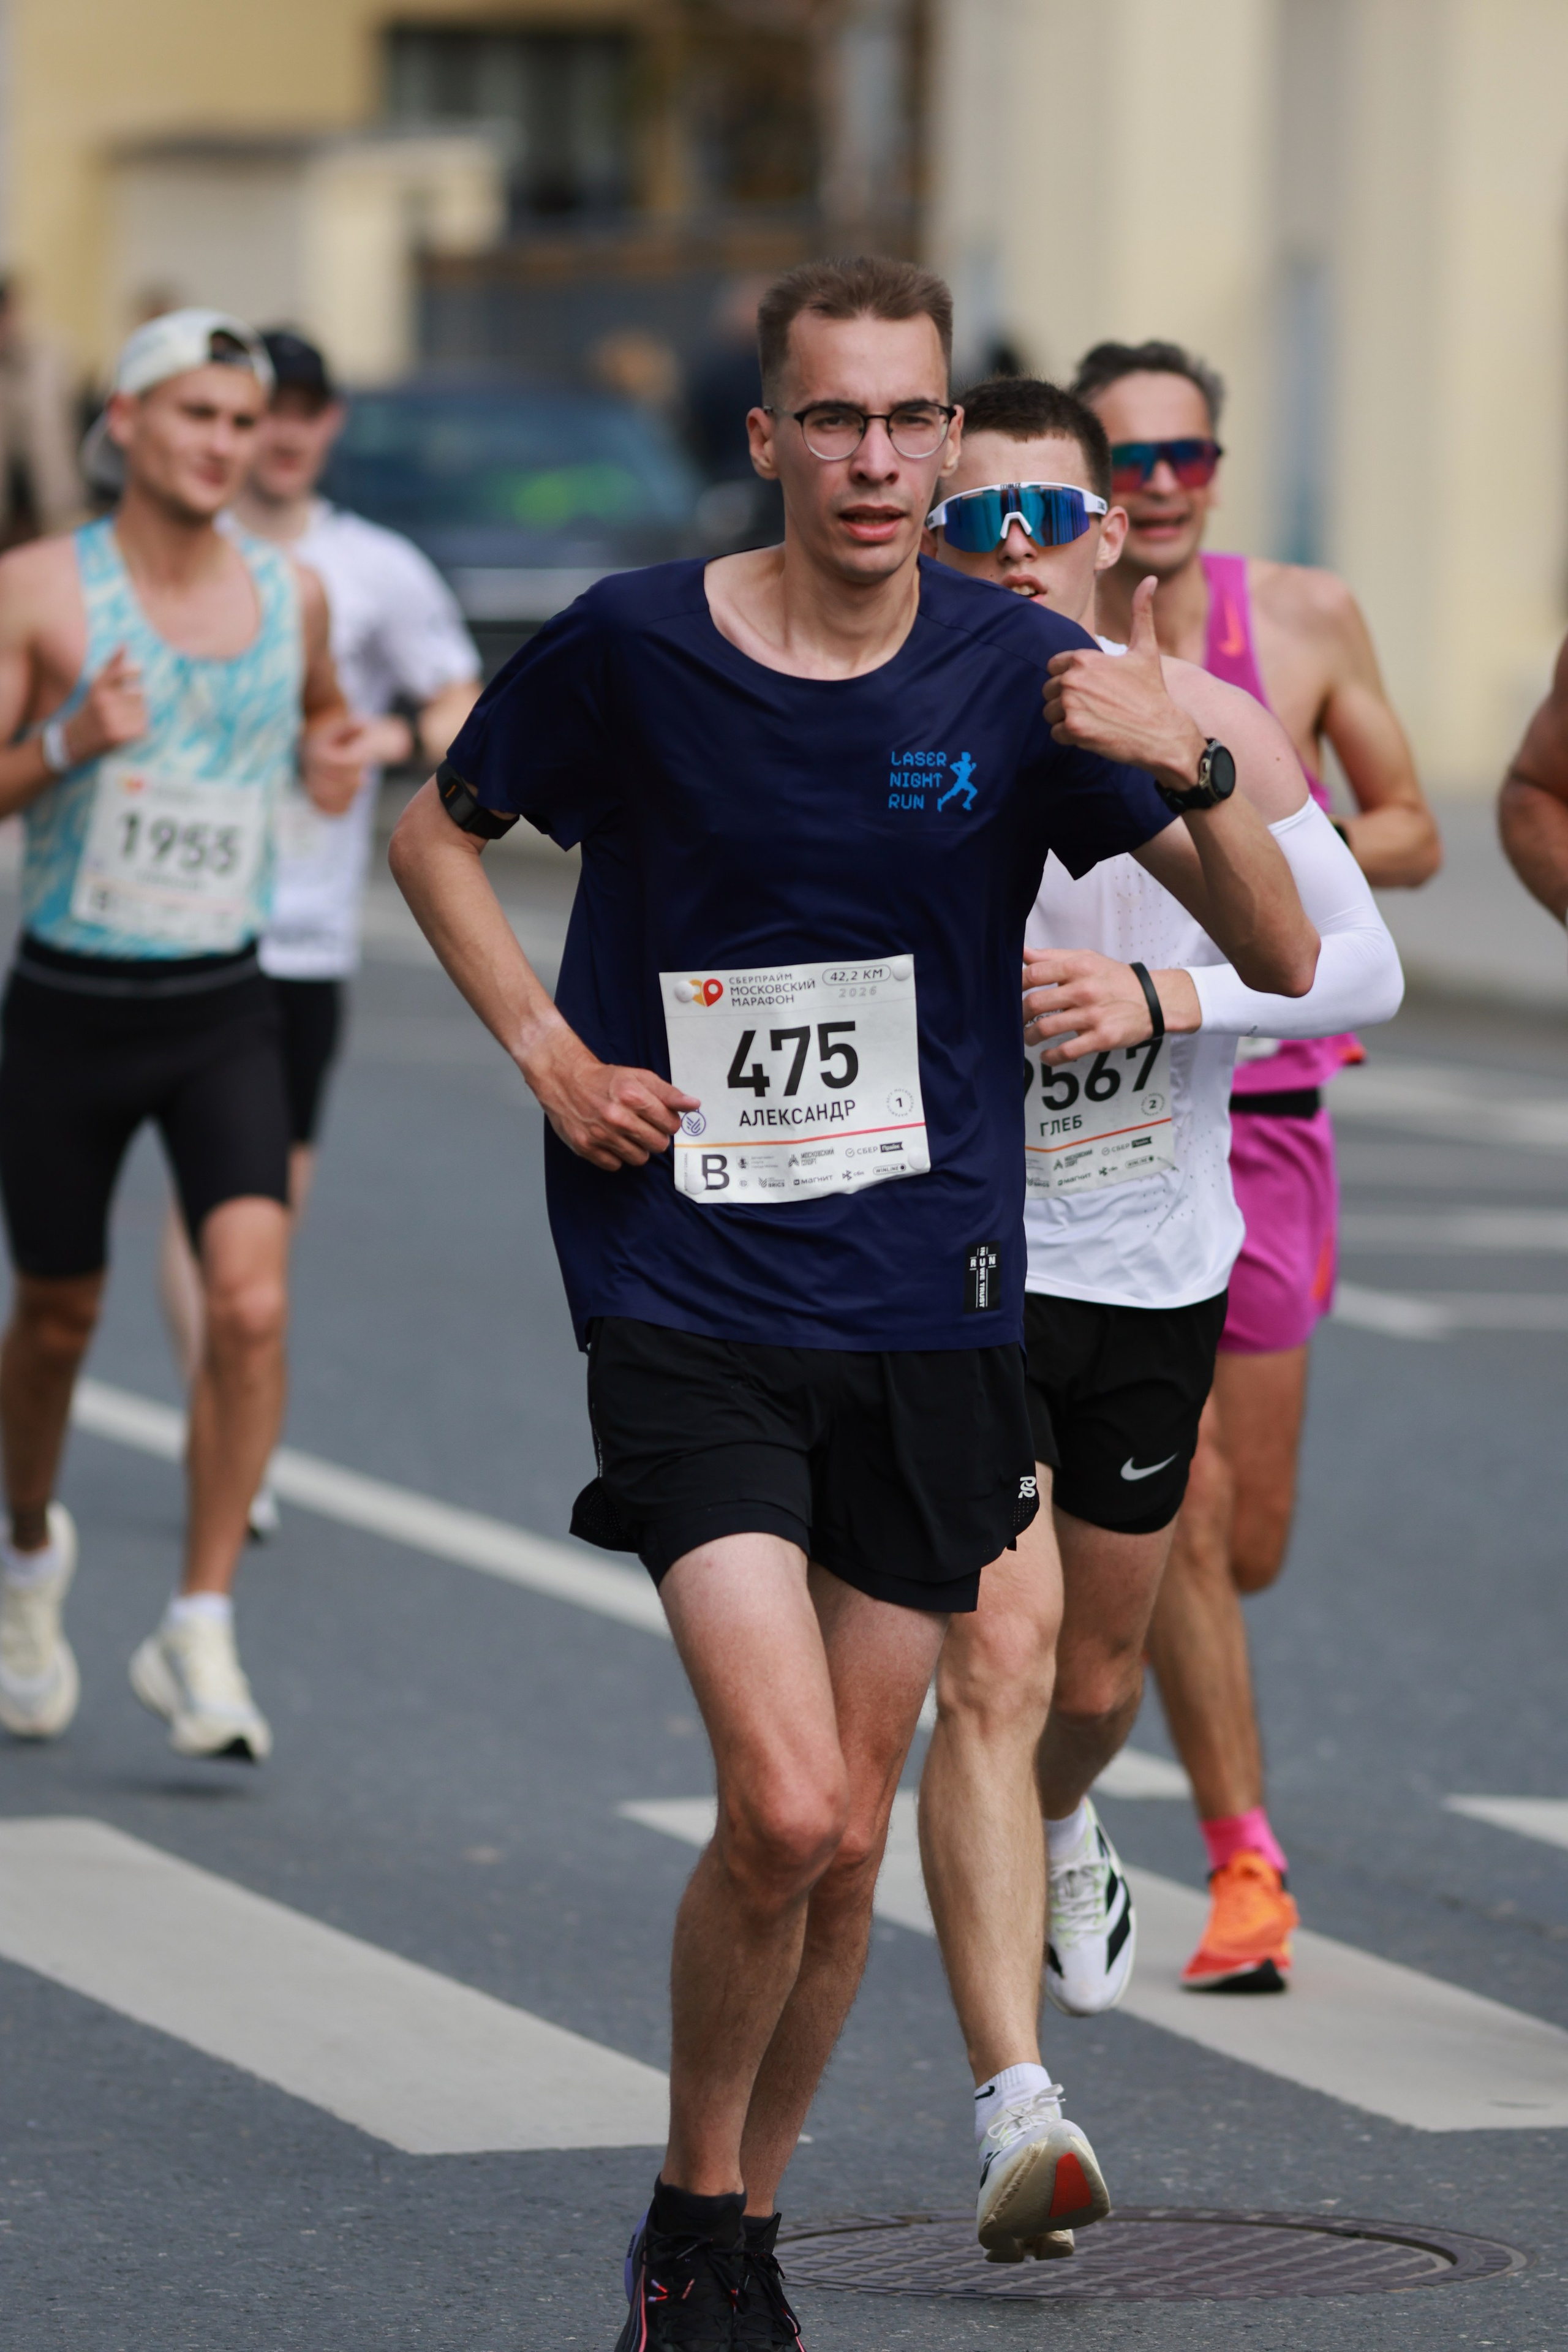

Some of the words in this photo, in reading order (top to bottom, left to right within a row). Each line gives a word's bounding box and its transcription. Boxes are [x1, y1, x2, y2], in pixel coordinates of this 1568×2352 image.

[891, 751, 947, 766] LASER
[889, 772, 943, 788] NIGHT
[888, 793, 924, 809] RUN
[729, 972, 793, 984] СБЕРПРАЙМ
[830, 971, 858, 981] 42,2
[730, 978, 816, 995] МОСКОВСКИЙ
[839, 986, 876, 998] 2026
[732, 995, 794, 1006] МАРАФОН
[727, 1020, 859, 1097] 475
[1024, 1036, 1163, 1111] 567
[895, 1097, 902, 1107] 1
[1149, 1099, 1156, 1109] 2
[739, 1099, 856, 1126] АЛЕКСАНДР
[1040, 1115, 1082, 1136] ГЛЕБ
[857, 1146, 878, 1155] СБЕР
[970, 1256, 996, 1267] RUN
